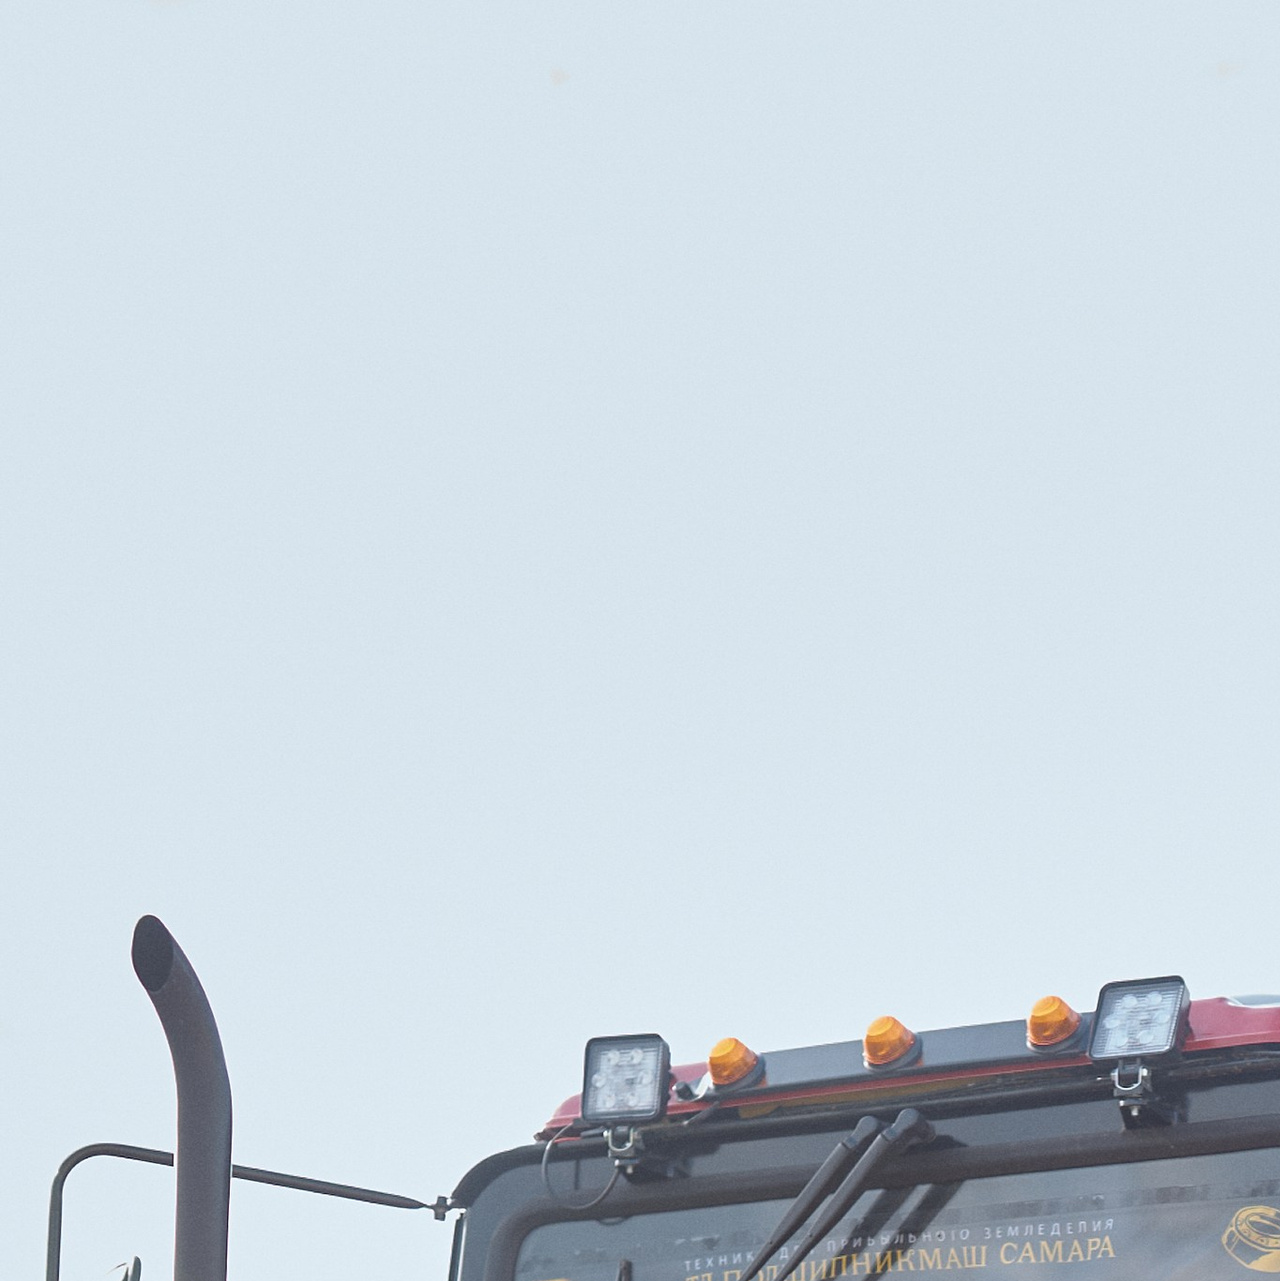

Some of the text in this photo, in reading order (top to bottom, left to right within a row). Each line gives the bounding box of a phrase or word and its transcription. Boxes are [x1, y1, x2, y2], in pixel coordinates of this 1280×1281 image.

[684, 1252, 756, 1272] ТЕХНИК
[983, 1218, 1115, 1241] ЗЕМЛЕДЕЛИЯ
[1000, 1235, 1117, 1265] САМАРА
